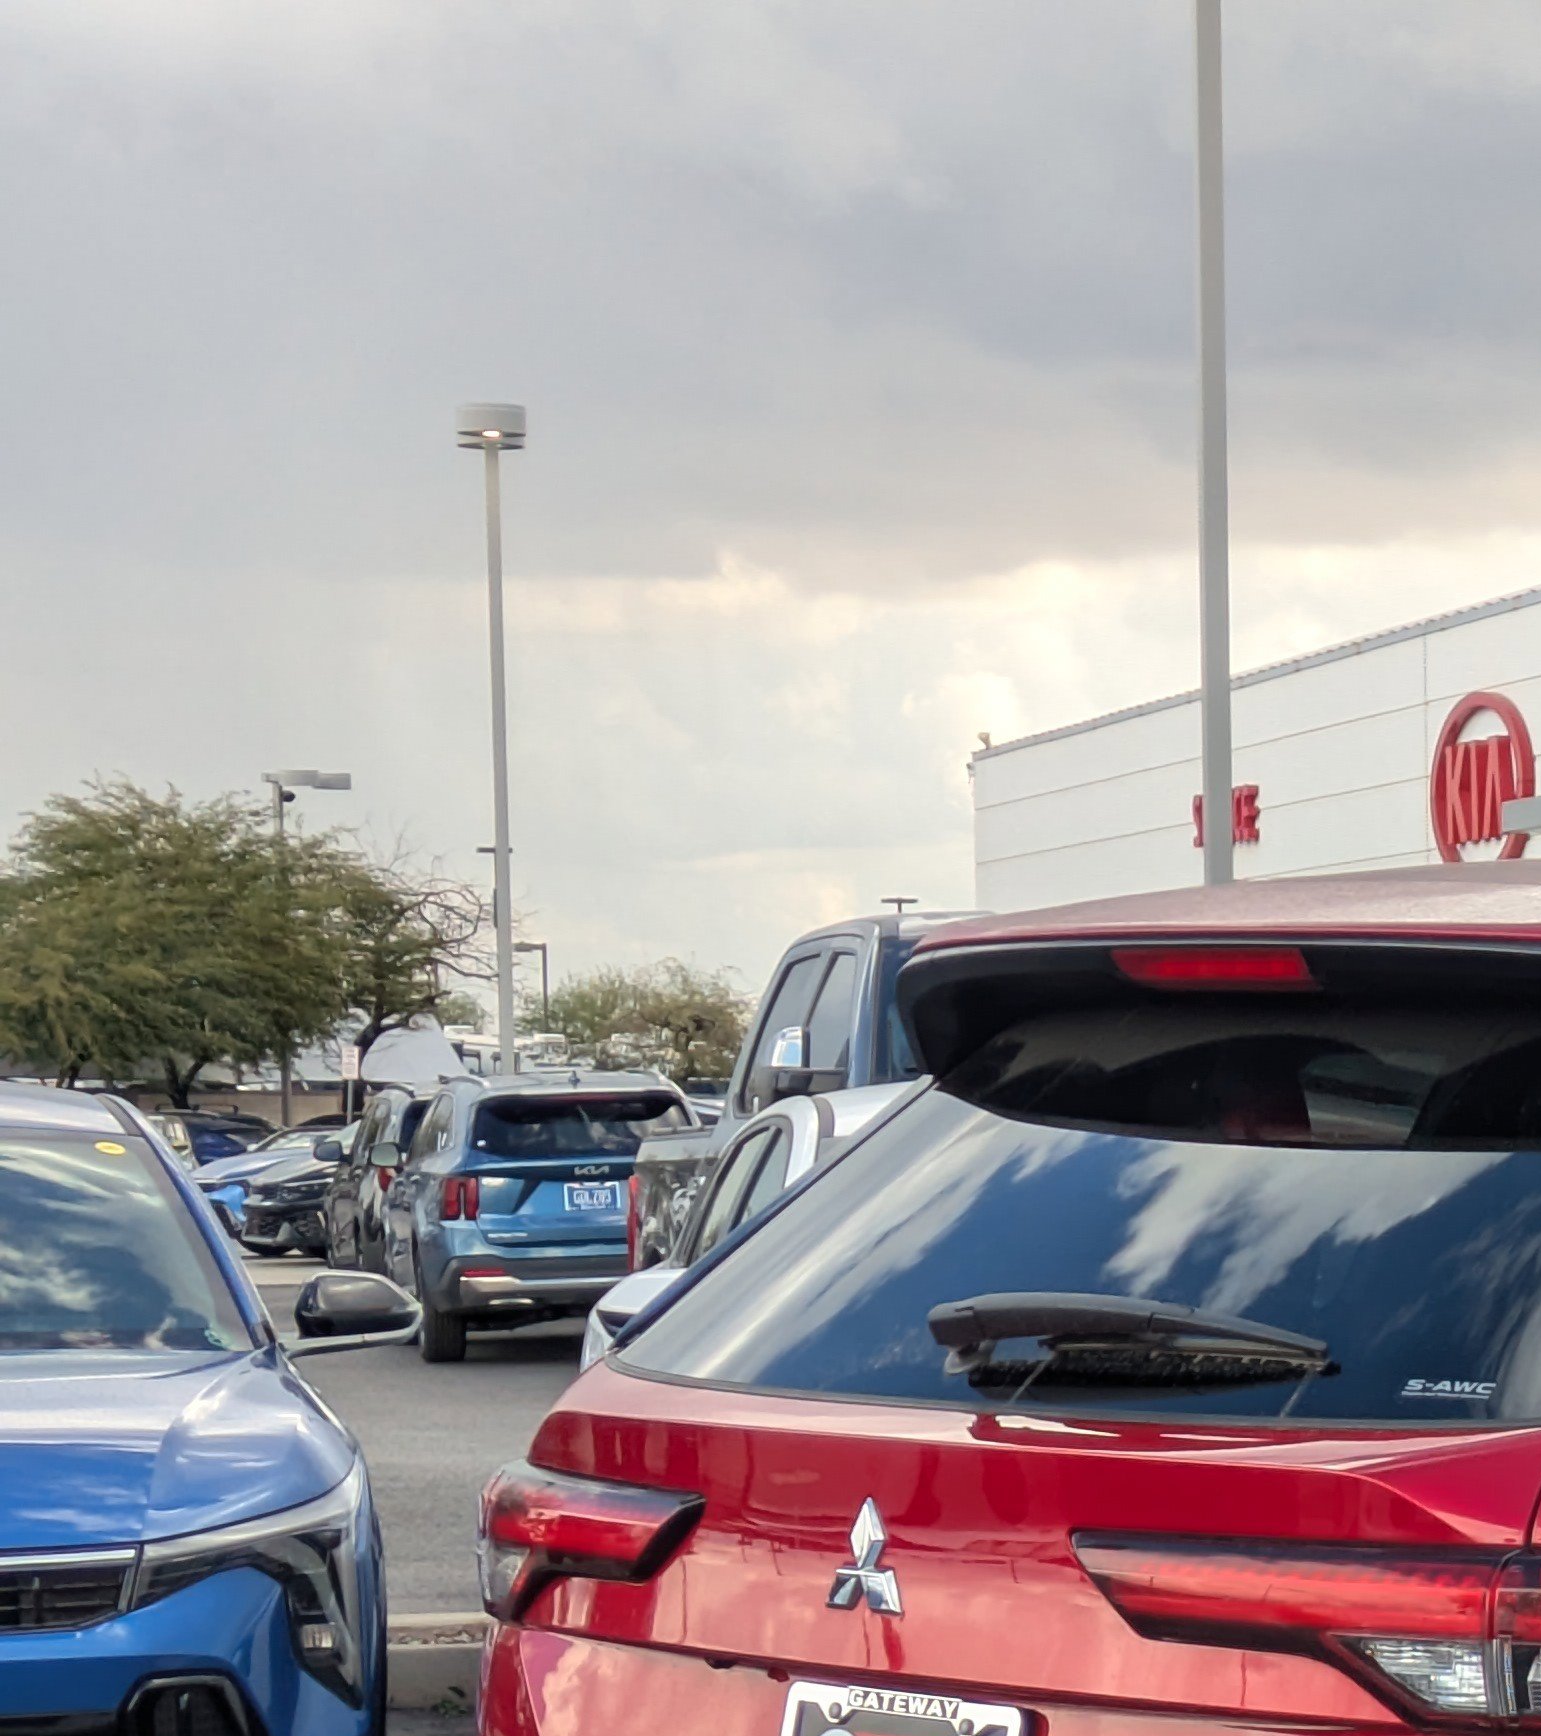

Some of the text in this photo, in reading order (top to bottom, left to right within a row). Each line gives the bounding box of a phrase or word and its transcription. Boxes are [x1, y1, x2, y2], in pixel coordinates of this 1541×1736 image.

[1445, 735, 1503, 844] KIA
[1404, 1378, 1497, 1395] S-AWC
[848, 1689, 958, 1719] GATEWAY
